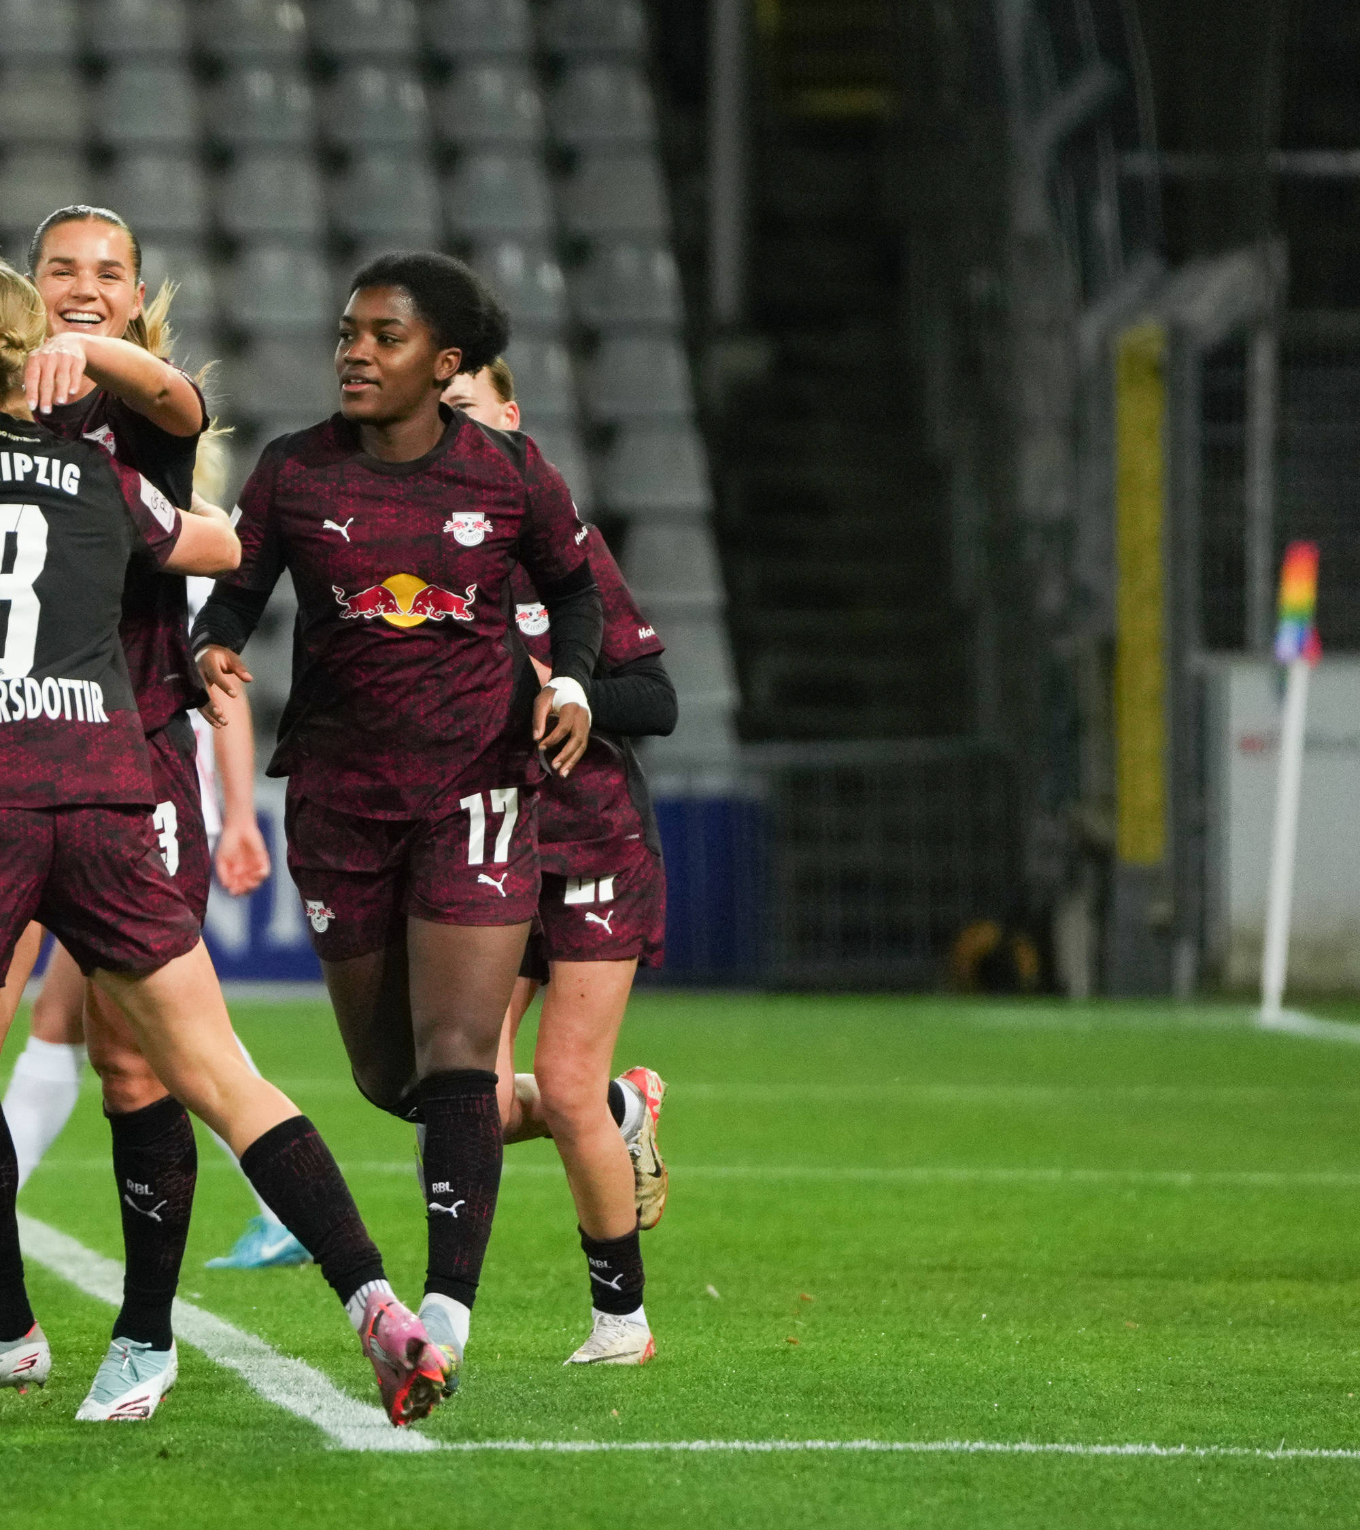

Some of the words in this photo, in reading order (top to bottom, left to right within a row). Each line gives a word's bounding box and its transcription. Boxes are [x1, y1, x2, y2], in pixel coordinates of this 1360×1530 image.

[459, 787, 519, 866] 17
[126, 1178, 154, 1196] RBL
[432, 1181, 454, 1194] RBL
